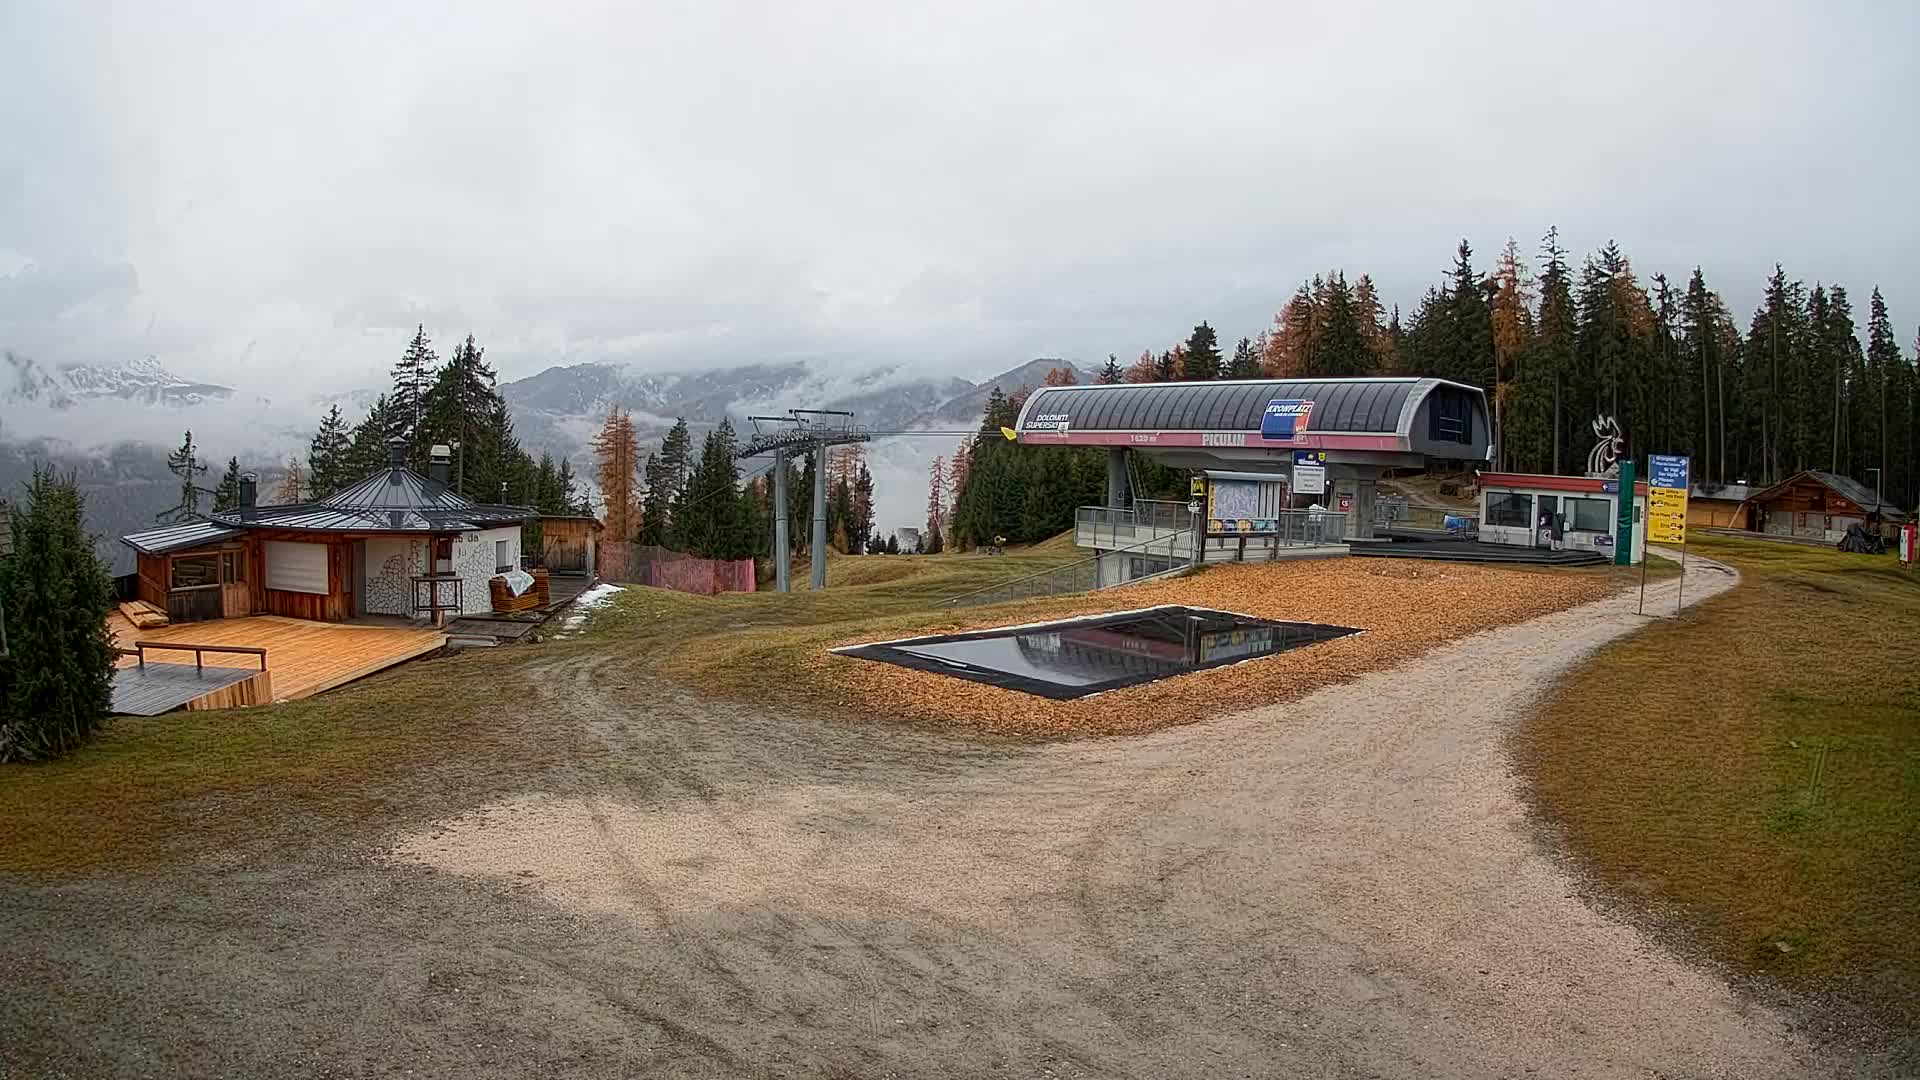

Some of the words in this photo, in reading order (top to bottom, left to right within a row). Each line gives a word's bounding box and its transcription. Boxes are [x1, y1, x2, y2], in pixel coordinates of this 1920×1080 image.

[1266, 403, 1311, 413] KRONPLATZ
[1026, 421, 1059, 429] SUPERSKI
[1202, 433, 1245, 447] PICULIN
